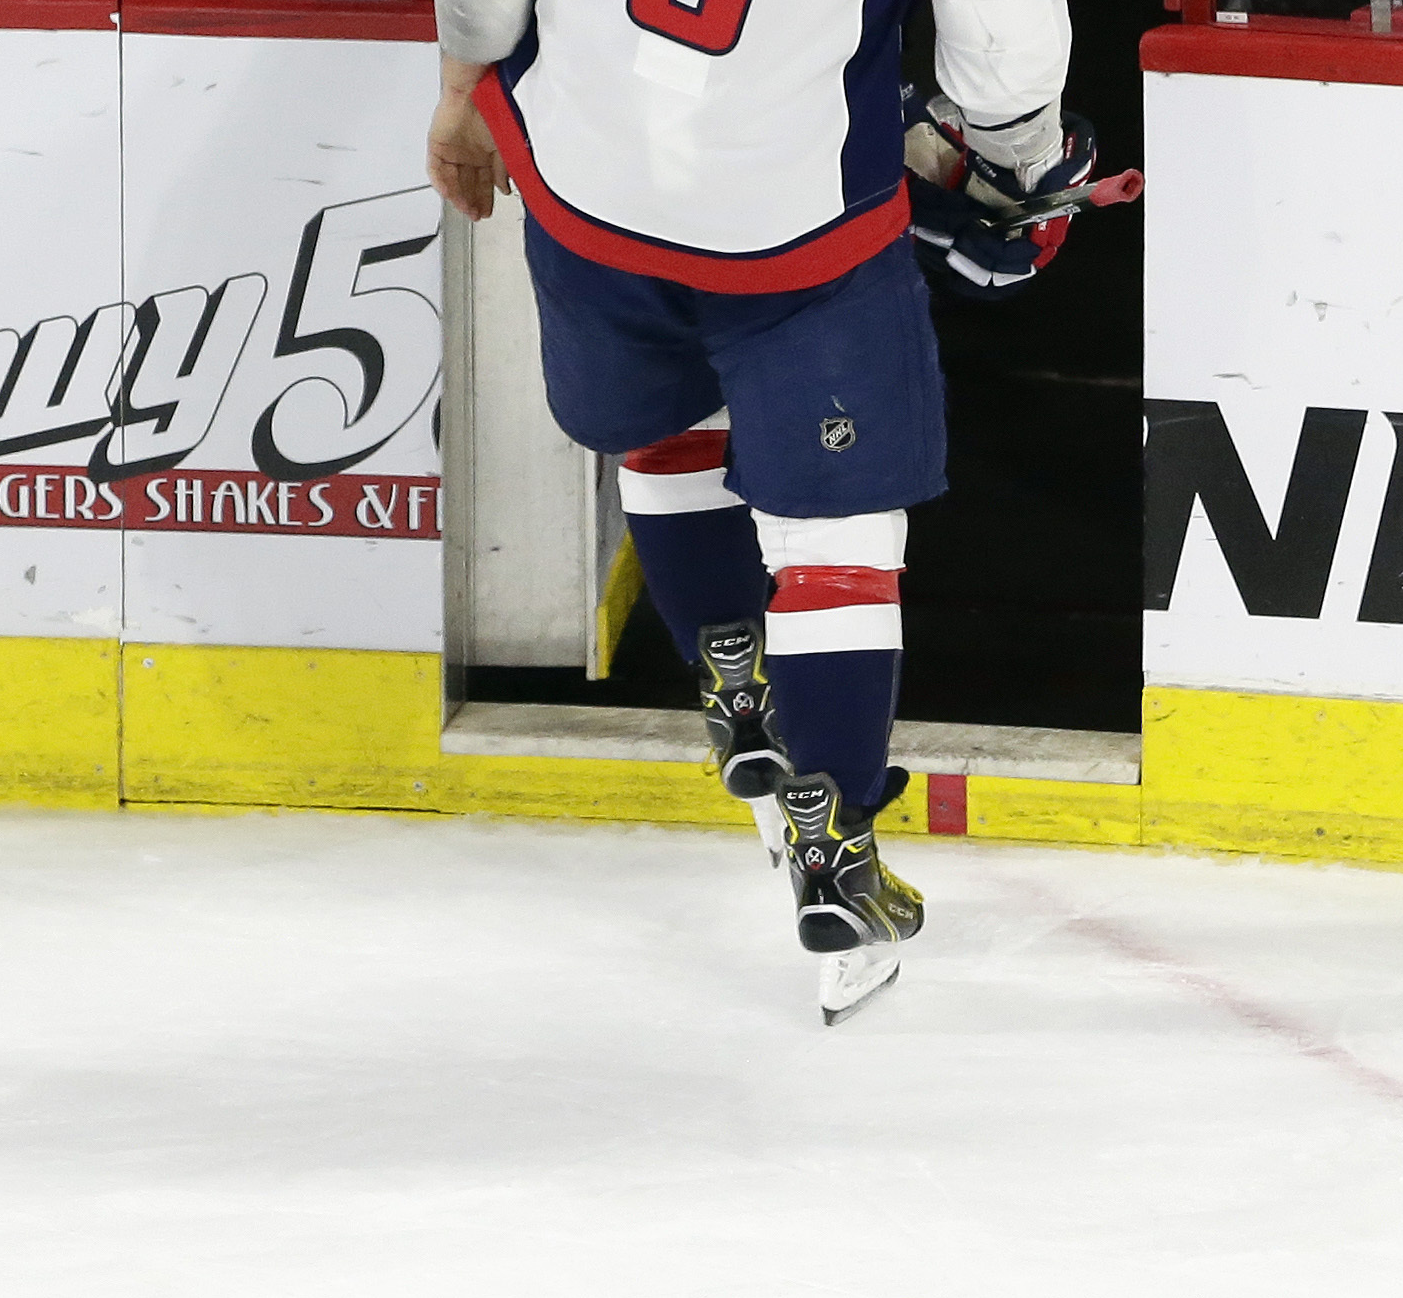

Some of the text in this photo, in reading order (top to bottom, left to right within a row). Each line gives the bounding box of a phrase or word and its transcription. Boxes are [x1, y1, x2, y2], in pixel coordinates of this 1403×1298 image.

[145, 477, 335, 528] SHAKES
[356, 483, 397, 530] &
[710, 634, 751, 648] CCM
[786, 788, 825, 801] CCM
[887, 902, 915, 920] CCM
